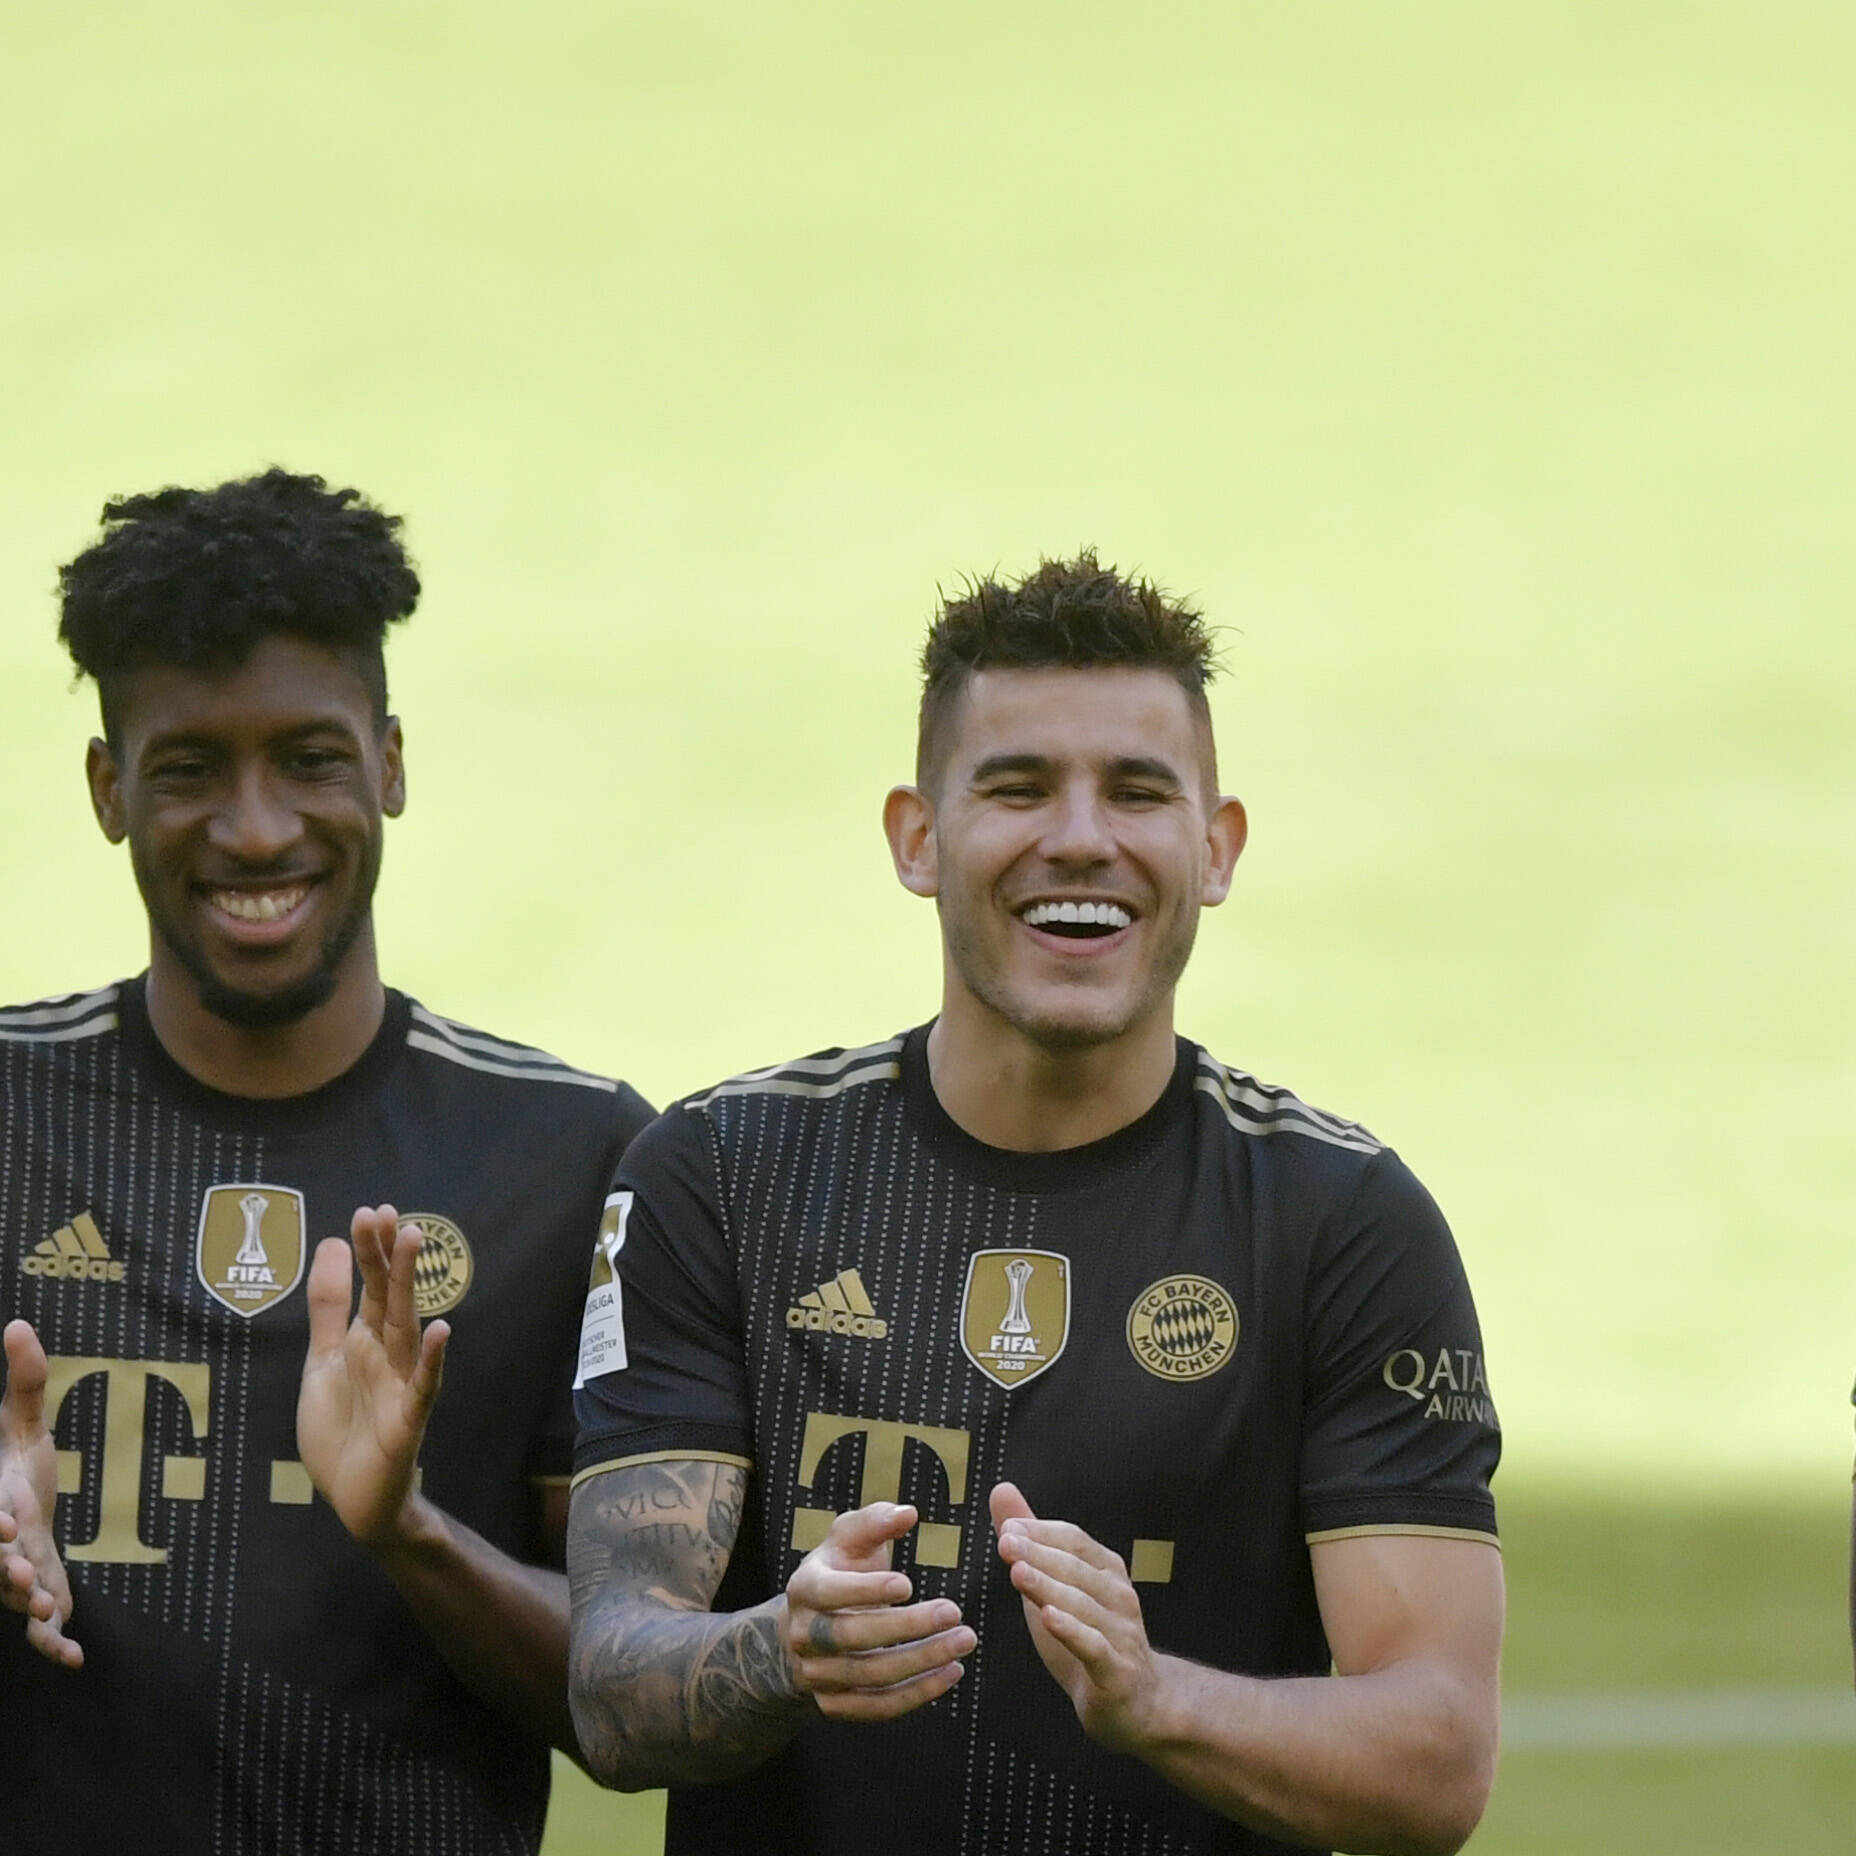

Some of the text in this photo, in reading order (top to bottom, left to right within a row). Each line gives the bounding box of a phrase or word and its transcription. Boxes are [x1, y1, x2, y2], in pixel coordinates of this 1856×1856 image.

[22, 1253, 124, 1282] adidas
[227, 1266, 274, 1283] FIFA
[1140, 1283, 1231, 1323] FC BAYERN
[785, 1306, 888, 1339] adidas
[990, 1335, 1037, 1353] FIFA
[1136, 1335, 1226, 1373] MÜNCHEN
[996, 1360, 1025, 1371] 2020
[1383, 1347, 1491, 1400] QATA
